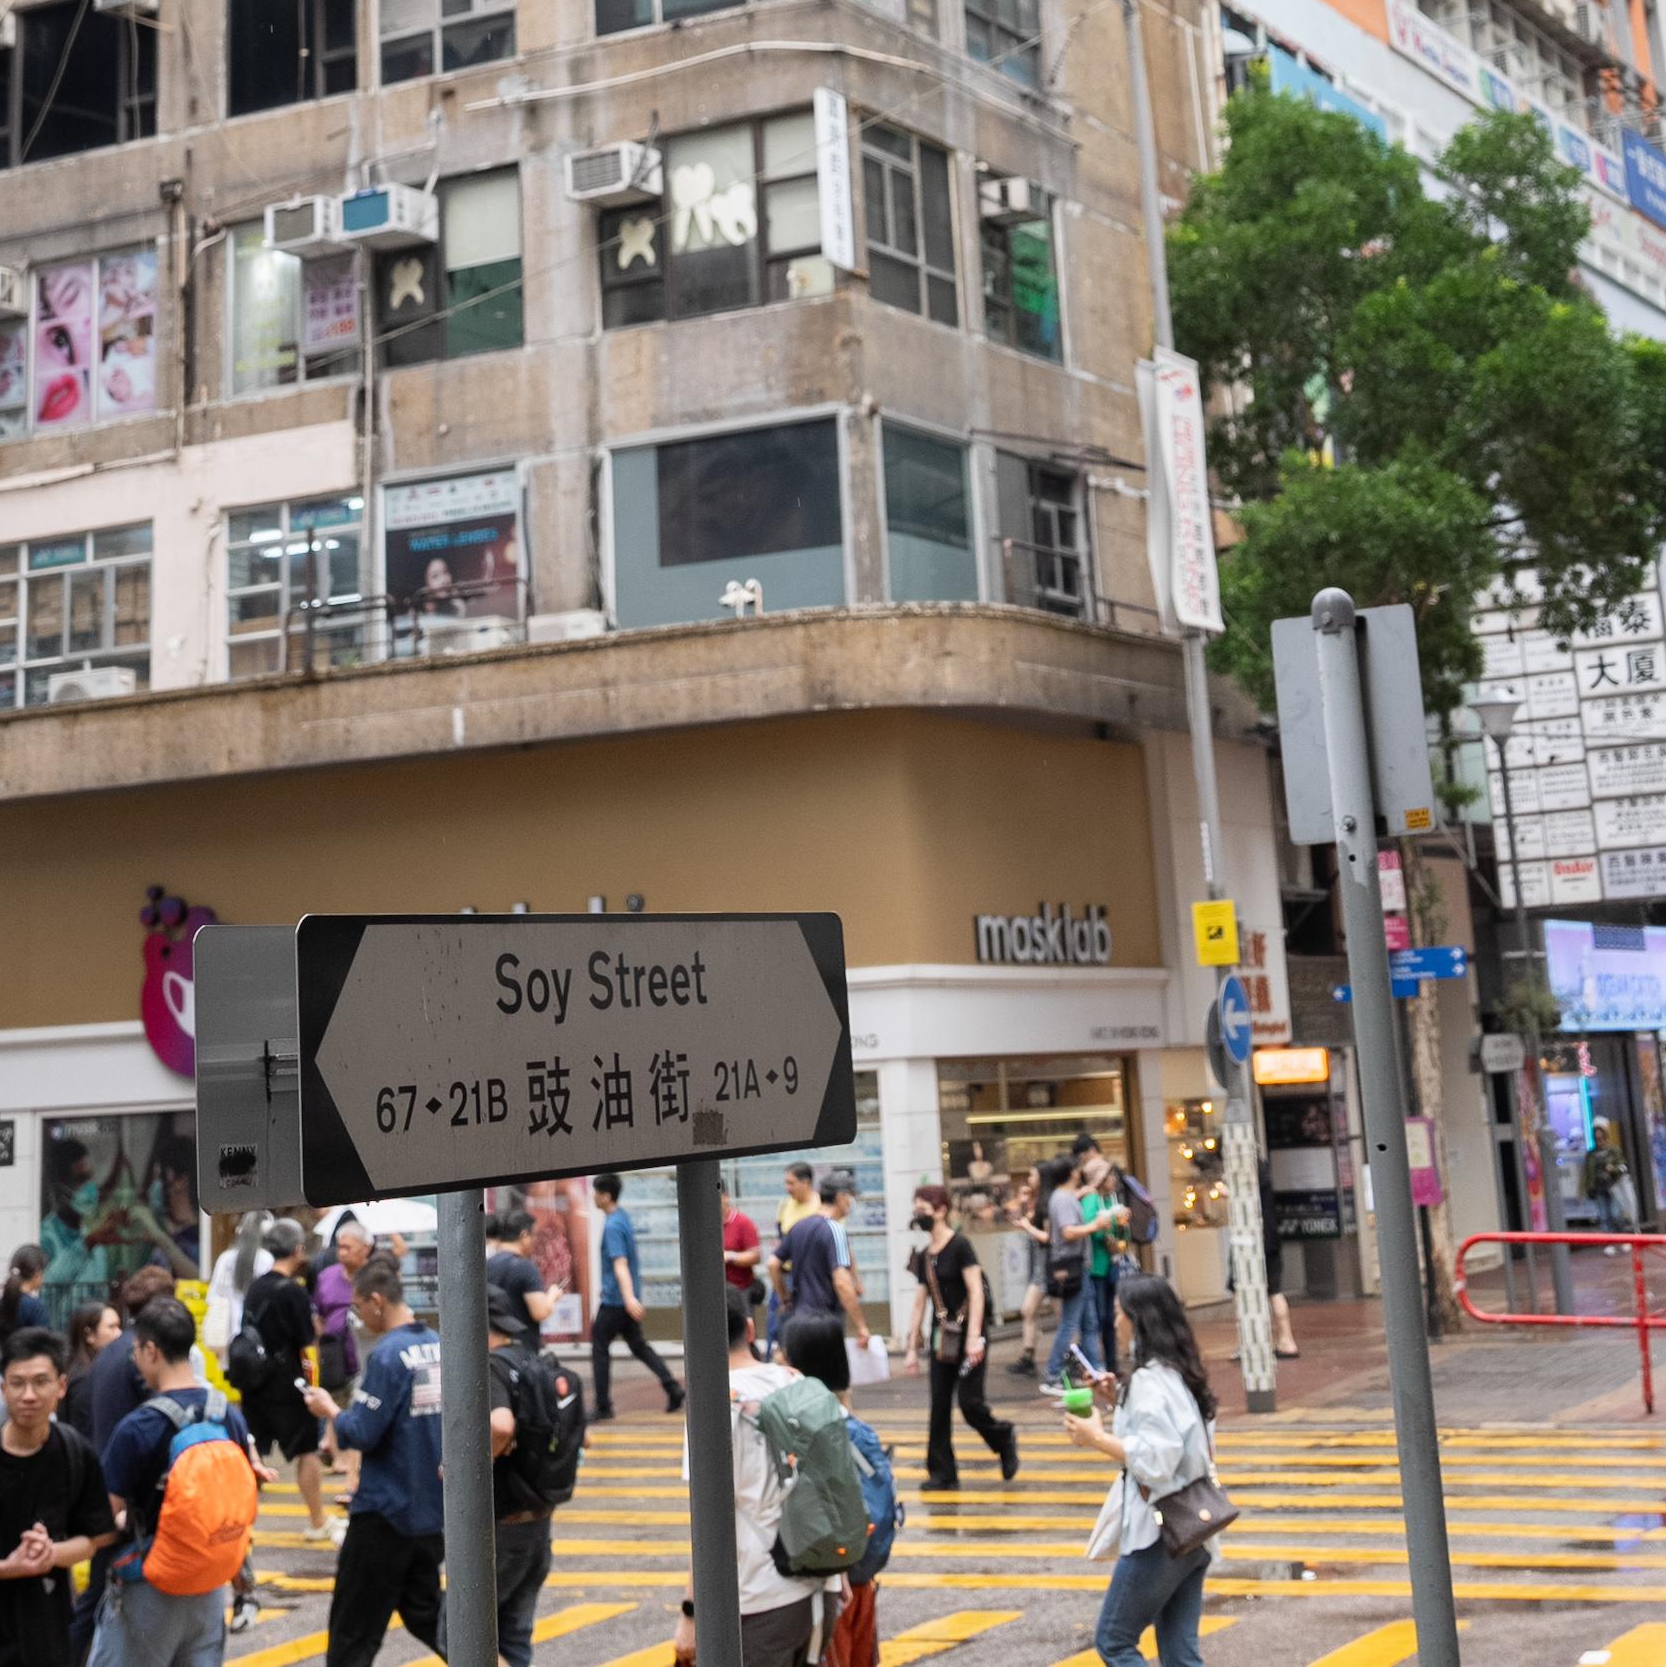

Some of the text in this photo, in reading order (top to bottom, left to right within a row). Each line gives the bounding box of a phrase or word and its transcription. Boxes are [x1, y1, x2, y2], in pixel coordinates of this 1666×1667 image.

[1587, 647, 1661, 690] 大廈
[974, 900, 1113, 965] masklab
[495, 950, 708, 1024] Soy Street
[376, 1049, 799, 1137] 67 21B 豉油街 21A 9
